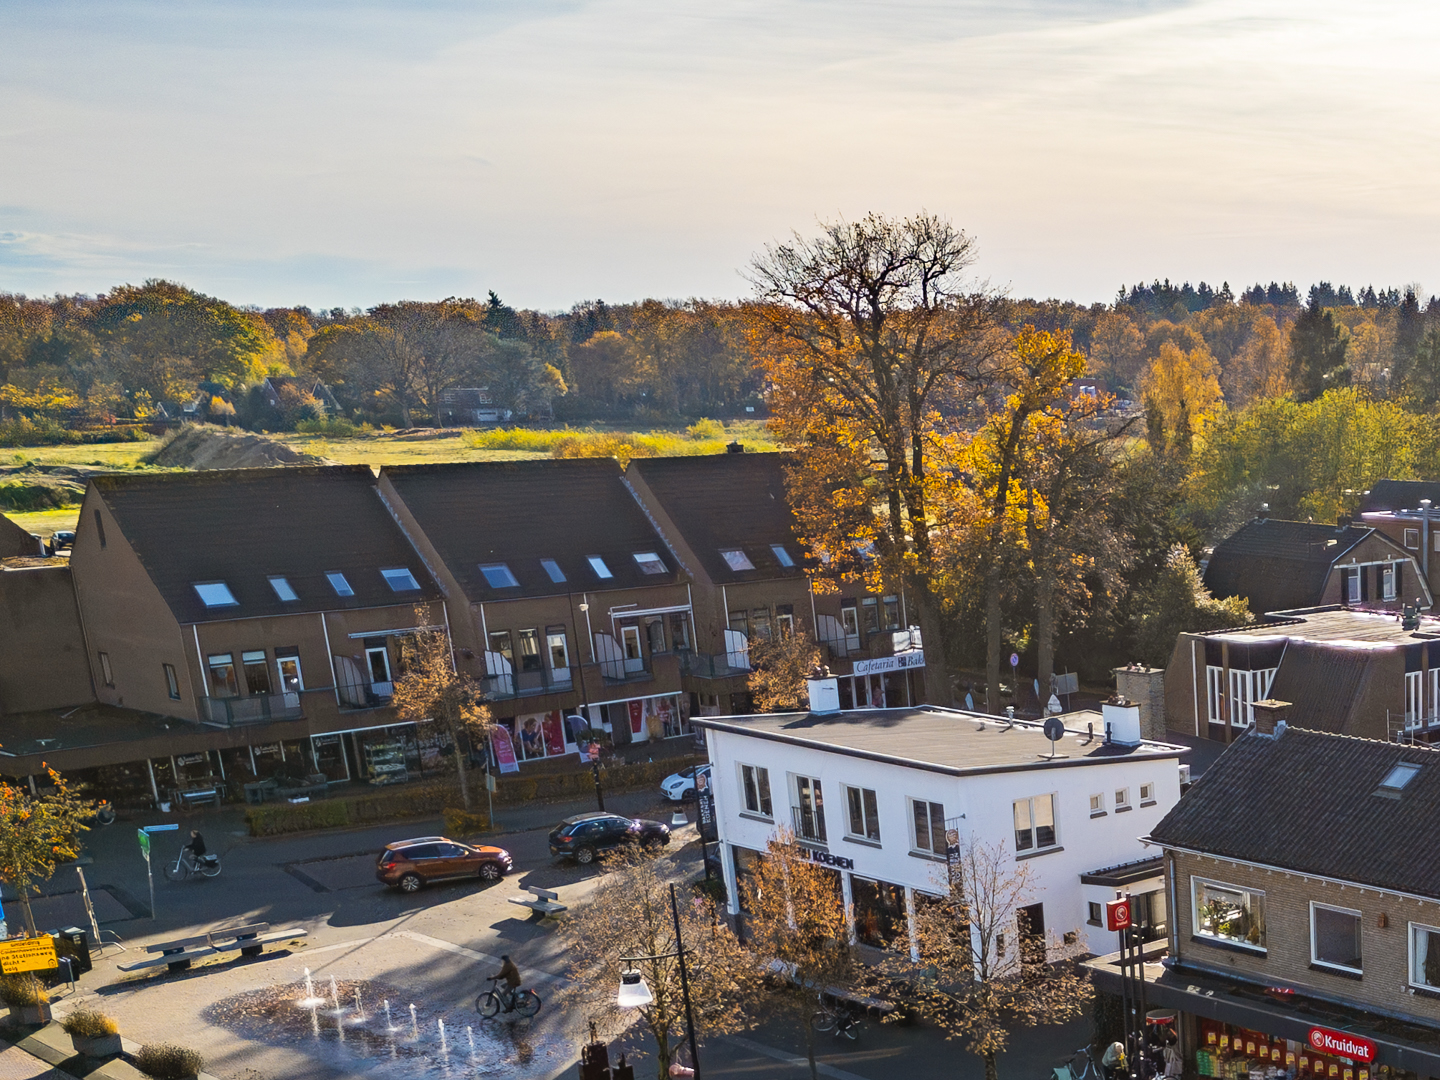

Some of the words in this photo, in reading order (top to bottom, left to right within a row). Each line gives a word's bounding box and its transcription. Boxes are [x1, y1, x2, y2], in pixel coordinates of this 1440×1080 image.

[856, 659, 894, 673] Cafetaria
[812, 851, 854, 869] KOENEN
[1324, 1034, 1369, 1057] Kruidvat
